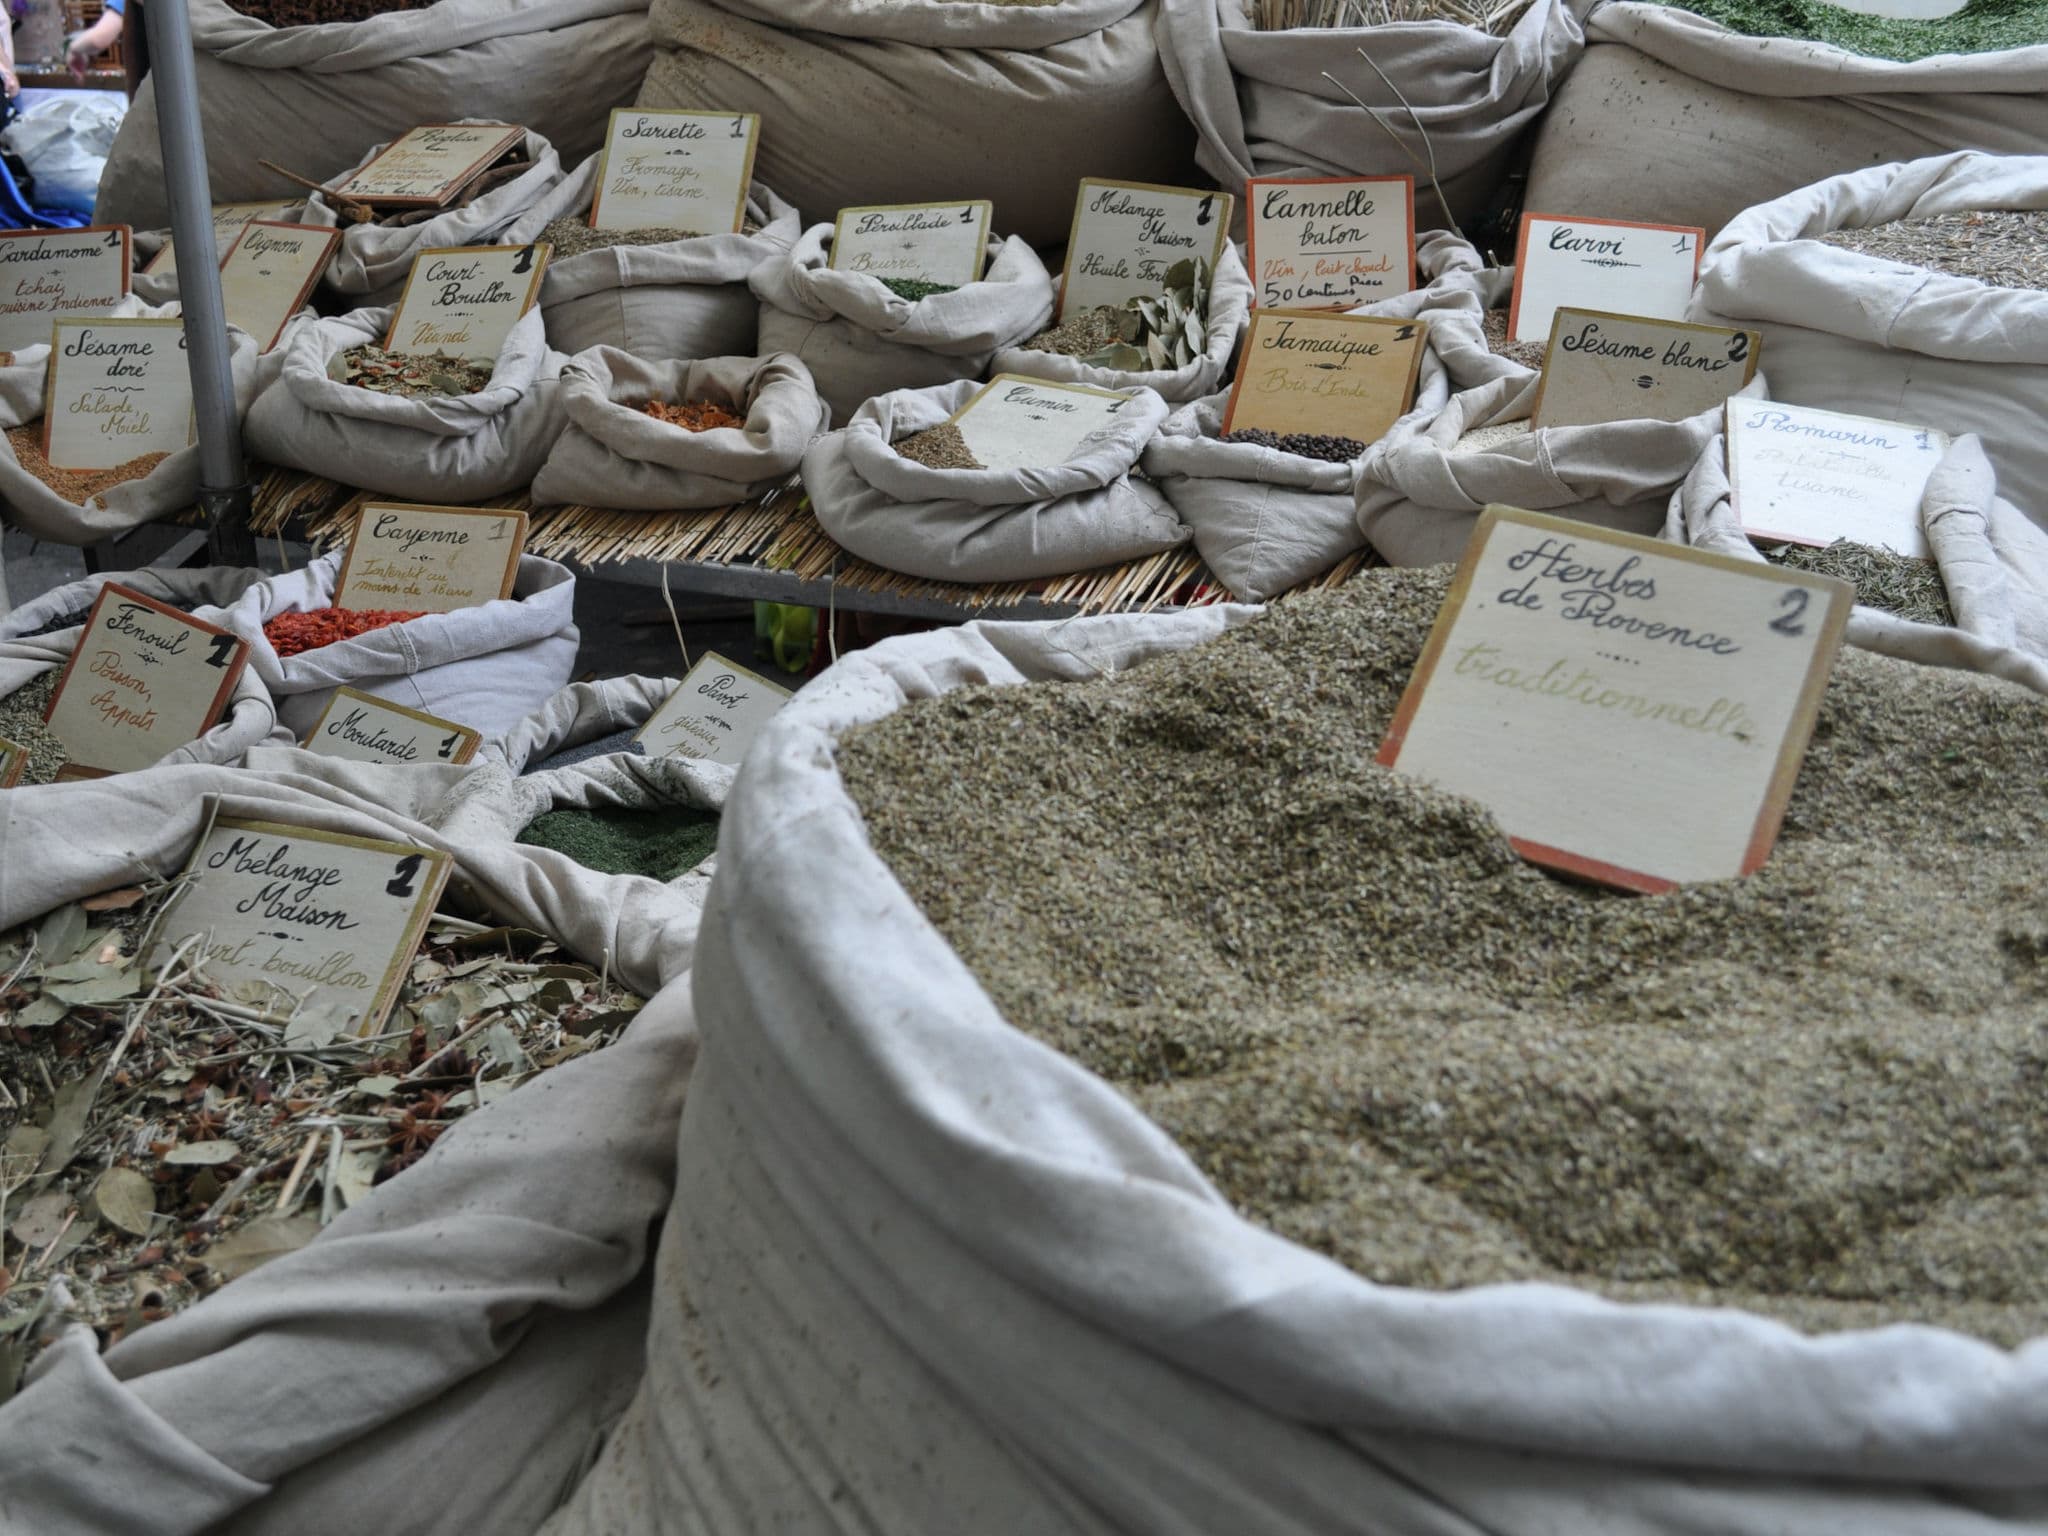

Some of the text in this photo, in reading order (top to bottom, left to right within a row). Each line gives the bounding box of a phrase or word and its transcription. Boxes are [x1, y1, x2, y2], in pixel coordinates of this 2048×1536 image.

[622, 114, 744, 139] Sariette 1
[960, 204, 974, 223] 1
[1263, 190, 1375, 219] Cannelle
[103, 229, 121, 248] 1
[1138, 221, 1197, 248] Maison
[1549, 225, 1692, 256] Carvi 1
[512, 244, 535, 274] 1
[1080, 253, 1129, 279] Huile
[432, 281, 517, 306] Bouillon
[1264, 281, 1293, 303] 50
[65, 329, 154, 357] Sésame
[1263, 320, 1416, 363] Jamaïque 1
[1562, 323, 1748, 371] Sésame blanc 2
[107, 357, 149, 377] doré
[1004, 386, 1127, 413] Cumin 1
[1745, 411, 1932, 449] Romarin 1
[373, 514, 511, 552] Cayenne 1
[403, 582, 421, 595] de
[1508, 538, 1806, 636] Herbes 2
[107, 604, 190, 655] Fenouil
[1497, 577, 1742, 655] de Provence
[698, 674, 749, 708] Pavot
[328, 708, 461, 760] Moutarde 1
[208, 837, 424, 901] Mélange 1
[236, 882, 359, 930] Maison
